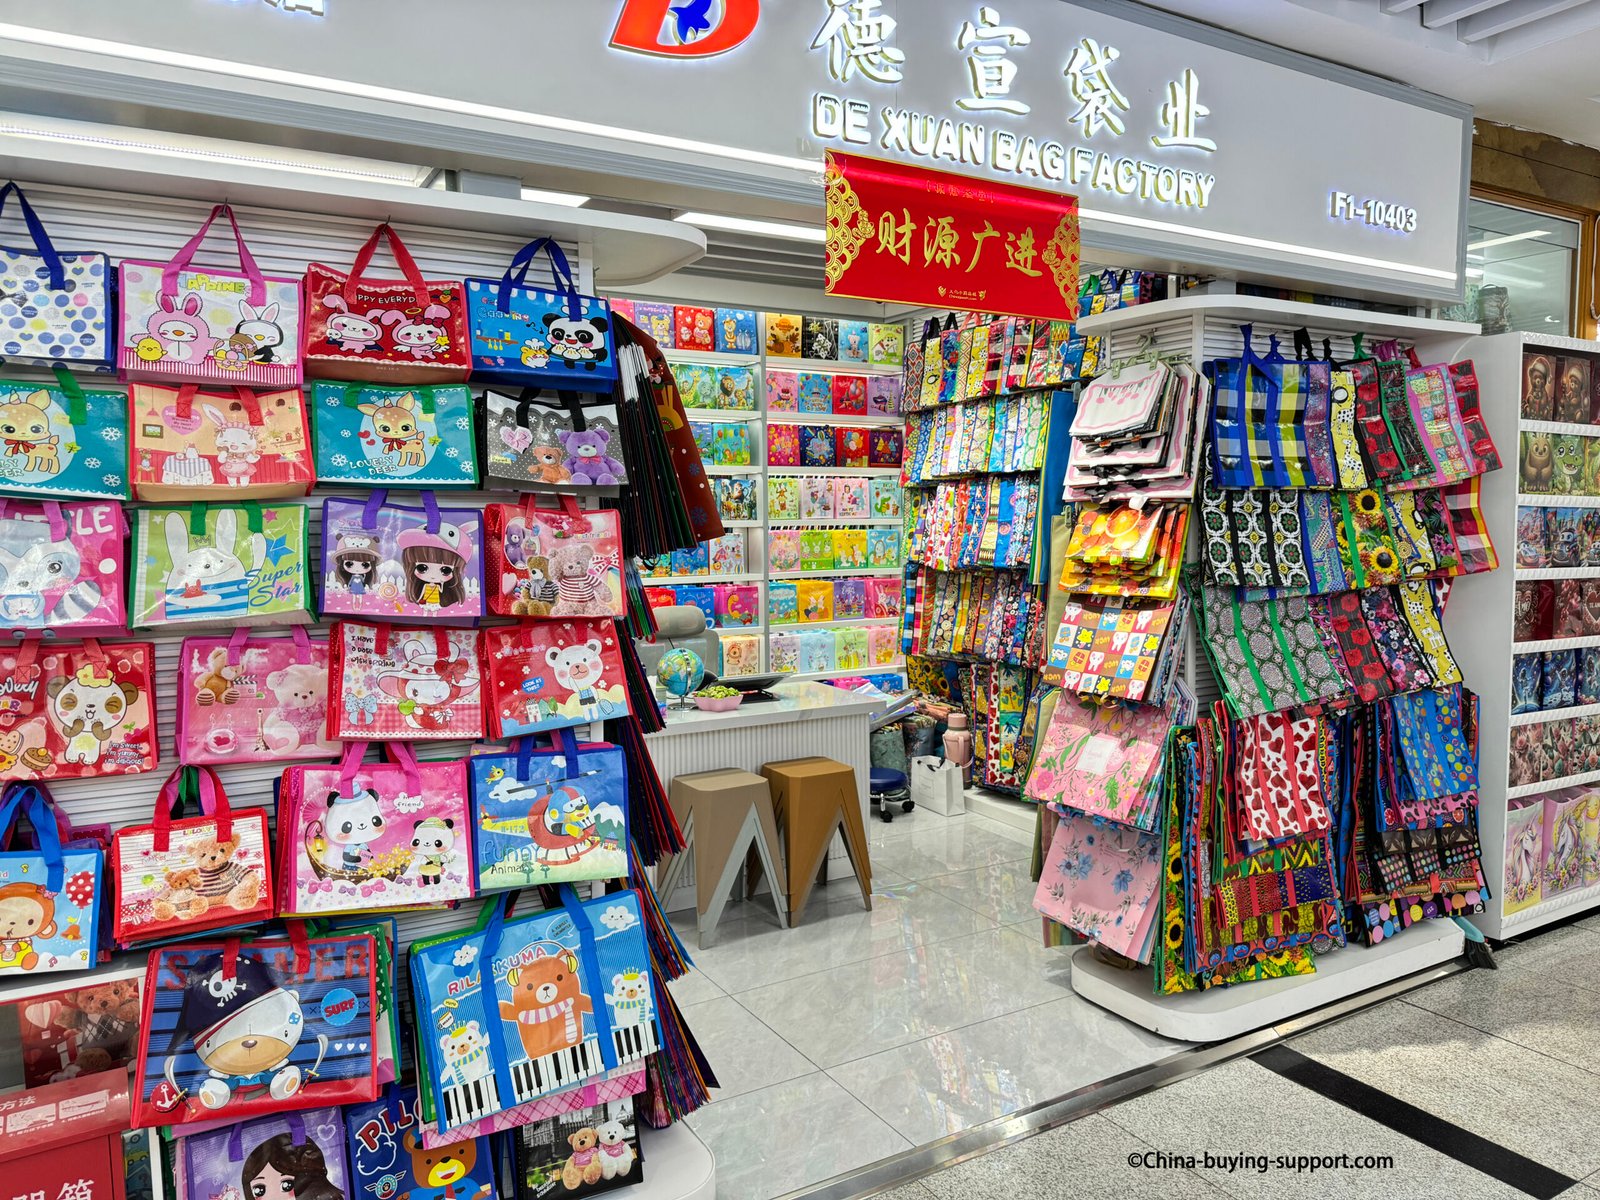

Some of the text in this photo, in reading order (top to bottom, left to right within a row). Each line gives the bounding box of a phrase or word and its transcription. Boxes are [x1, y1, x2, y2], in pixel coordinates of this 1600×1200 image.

[810, 0, 1218, 151] 德宣袋业
[813, 93, 1216, 208] DE XUAN BAG FACTORY
[1330, 191, 1418, 233] F1-10403
[876, 208, 1043, 277] 财源广进
[356, 293, 416, 304] PPY EVERYD
[349, 456, 394, 469] LOVELY
[368, 465, 398, 475] DEER
[237, 561, 304, 590] Super
[250, 580, 304, 607] Star
[164, 944, 371, 990] SMER
[448, 945, 548, 996] RILKUMA
[323, 998, 356, 1018] SURF
